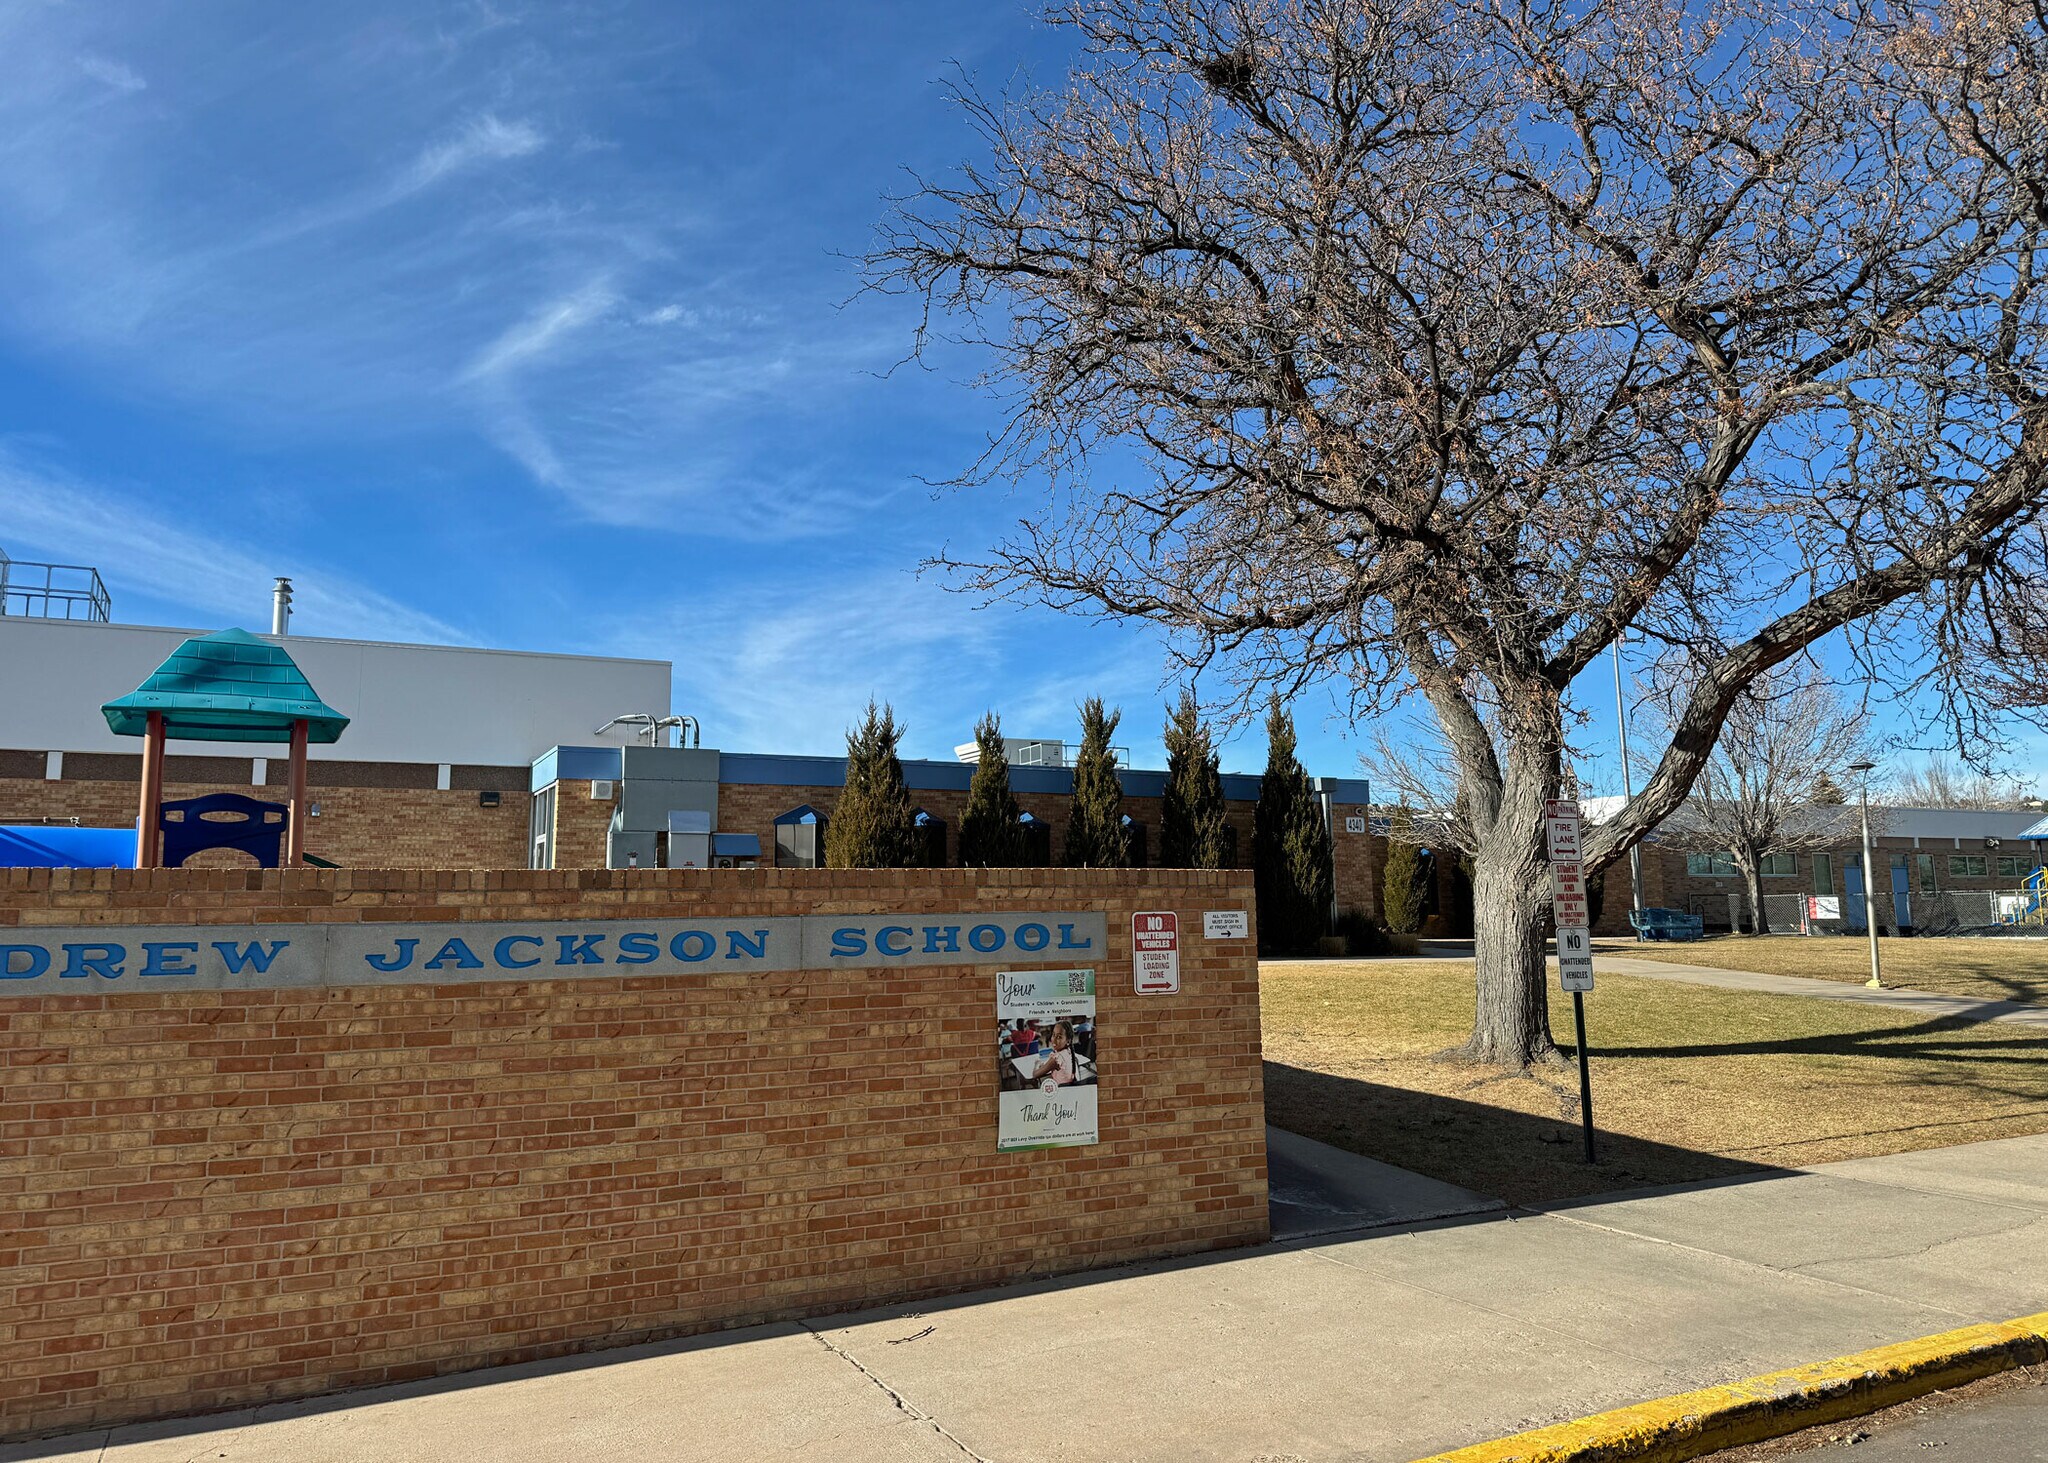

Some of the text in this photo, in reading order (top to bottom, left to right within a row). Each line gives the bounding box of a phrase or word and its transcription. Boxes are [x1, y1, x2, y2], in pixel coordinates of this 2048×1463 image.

[1548, 803, 1577, 816] NO PARKING
[1349, 818, 1363, 831] 4340
[1555, 823, 1573, 832] FIRE
[1554, 835, 1576, 844] LANE
[1556, 865, 1578, 873] STUDENT
[1557, 874, 1579, 882] LOADING
[1564, 884, 1575, 892] AND
[1556, 893, 1584, 901] UNLOADING
[1564, 903, 1578, 911] ONLY
[1147, 916, 1163, 930] NO
[1136, 931, 1175, 940] UNATTENDED
[1141, 940, 1171, 949] VEHICLES
[1566, 934, 1581, 949] NO
[0, 923, 1092, 979] DREW JACKSON SCHOOL
[1142, 953, 1170, 961] STUDENT
[1561, 957, 1590, 966] UNATTENDED
[1143, 961, 1170, 970] LOADING
[1149, 970, 1165, 979] ZONE
[1566, 970, 1589, 979] VEHICLES
[998, 973, 1036, 1006] Your
[1060, 998, 1089, 1006] Grandchildren
[1020, 1100, 1078, 1126] Thank You!
